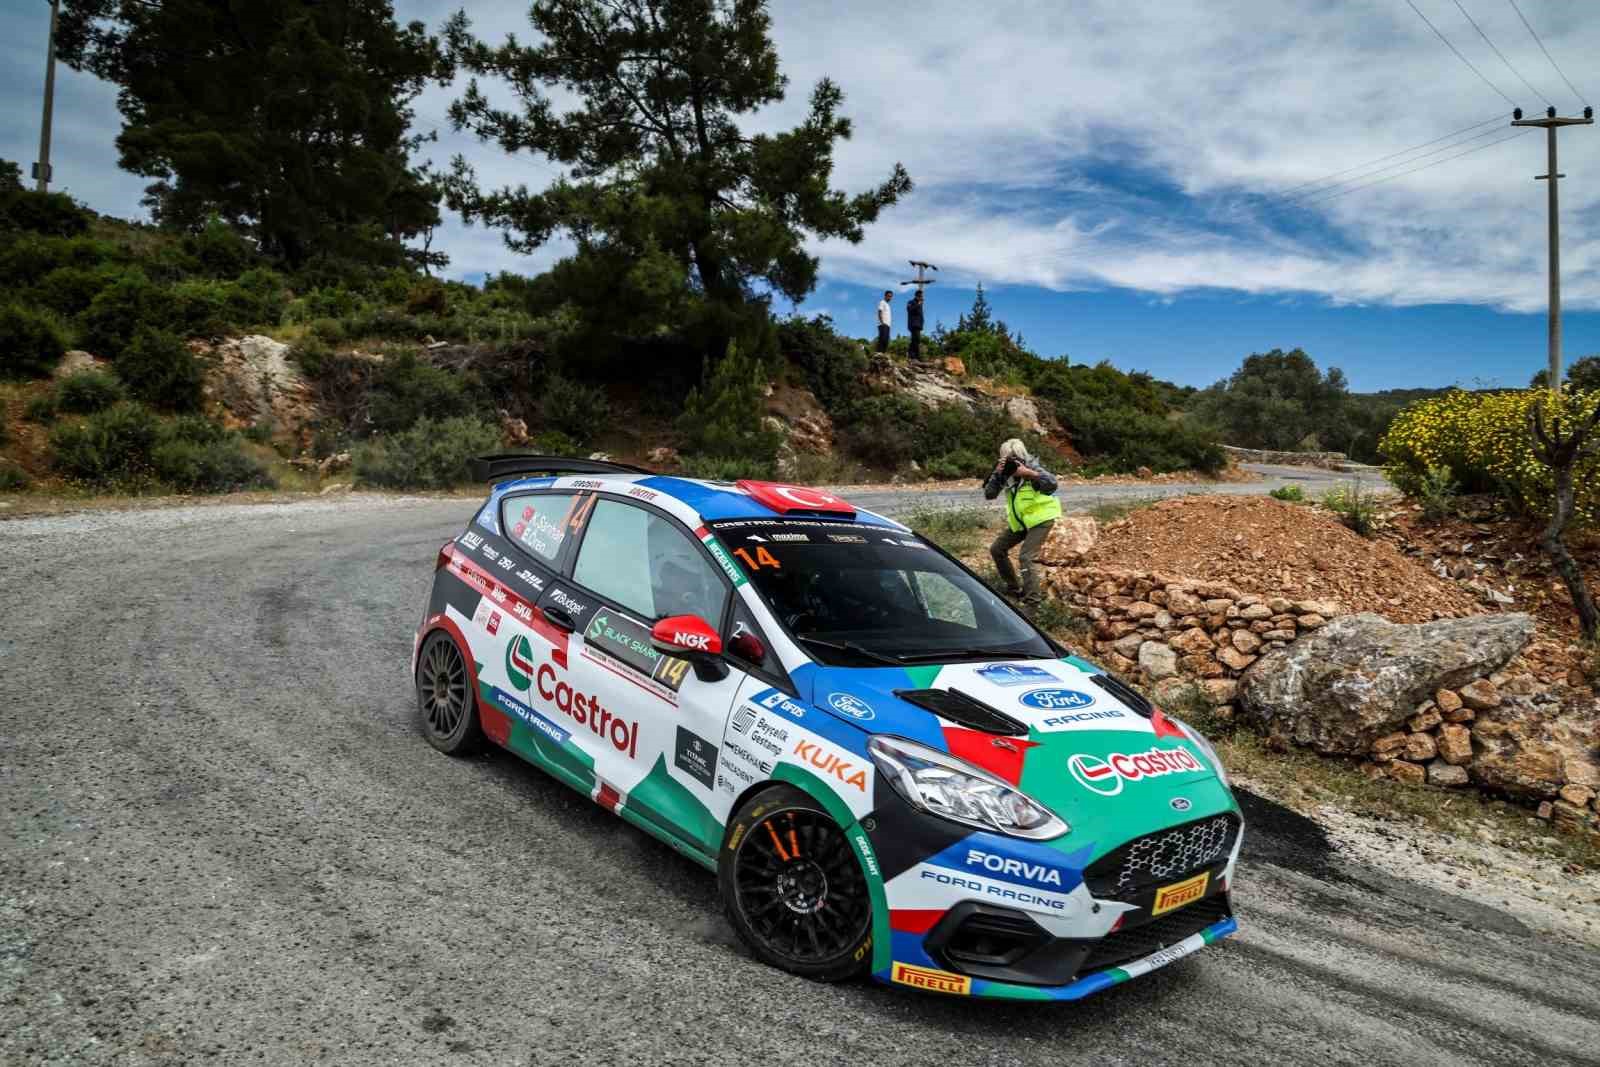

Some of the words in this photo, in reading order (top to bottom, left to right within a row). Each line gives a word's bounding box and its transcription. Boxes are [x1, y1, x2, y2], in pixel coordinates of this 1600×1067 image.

[713, 519, 784, 528] CASTROL
[733, 546, 781, 571] 14
[559, 593, 588, 616] Budget
[606, 626, 632, 646] BLACK
[630, 640, 661, 661] SHARK
[673, 631, 710, 651] NGK
[659, 656, 690, 686] 14
[498, 693, 525, 716] FORD
[537, 663, 639, 760] Castrol
[1043, 710, 1126, 728] RACING
[793, 739, 866, 792] KUKA
[1109, 746, 1201, 781] Castrol
[966, 849, 1062, 887] FORVIA
[920, 870, 982, 892] FORD
[985, 883, 1066, 910] RACING
[1159, 875, 1207, 911] PIRELLI
[896, 966, 970, 994] PIRELLI
